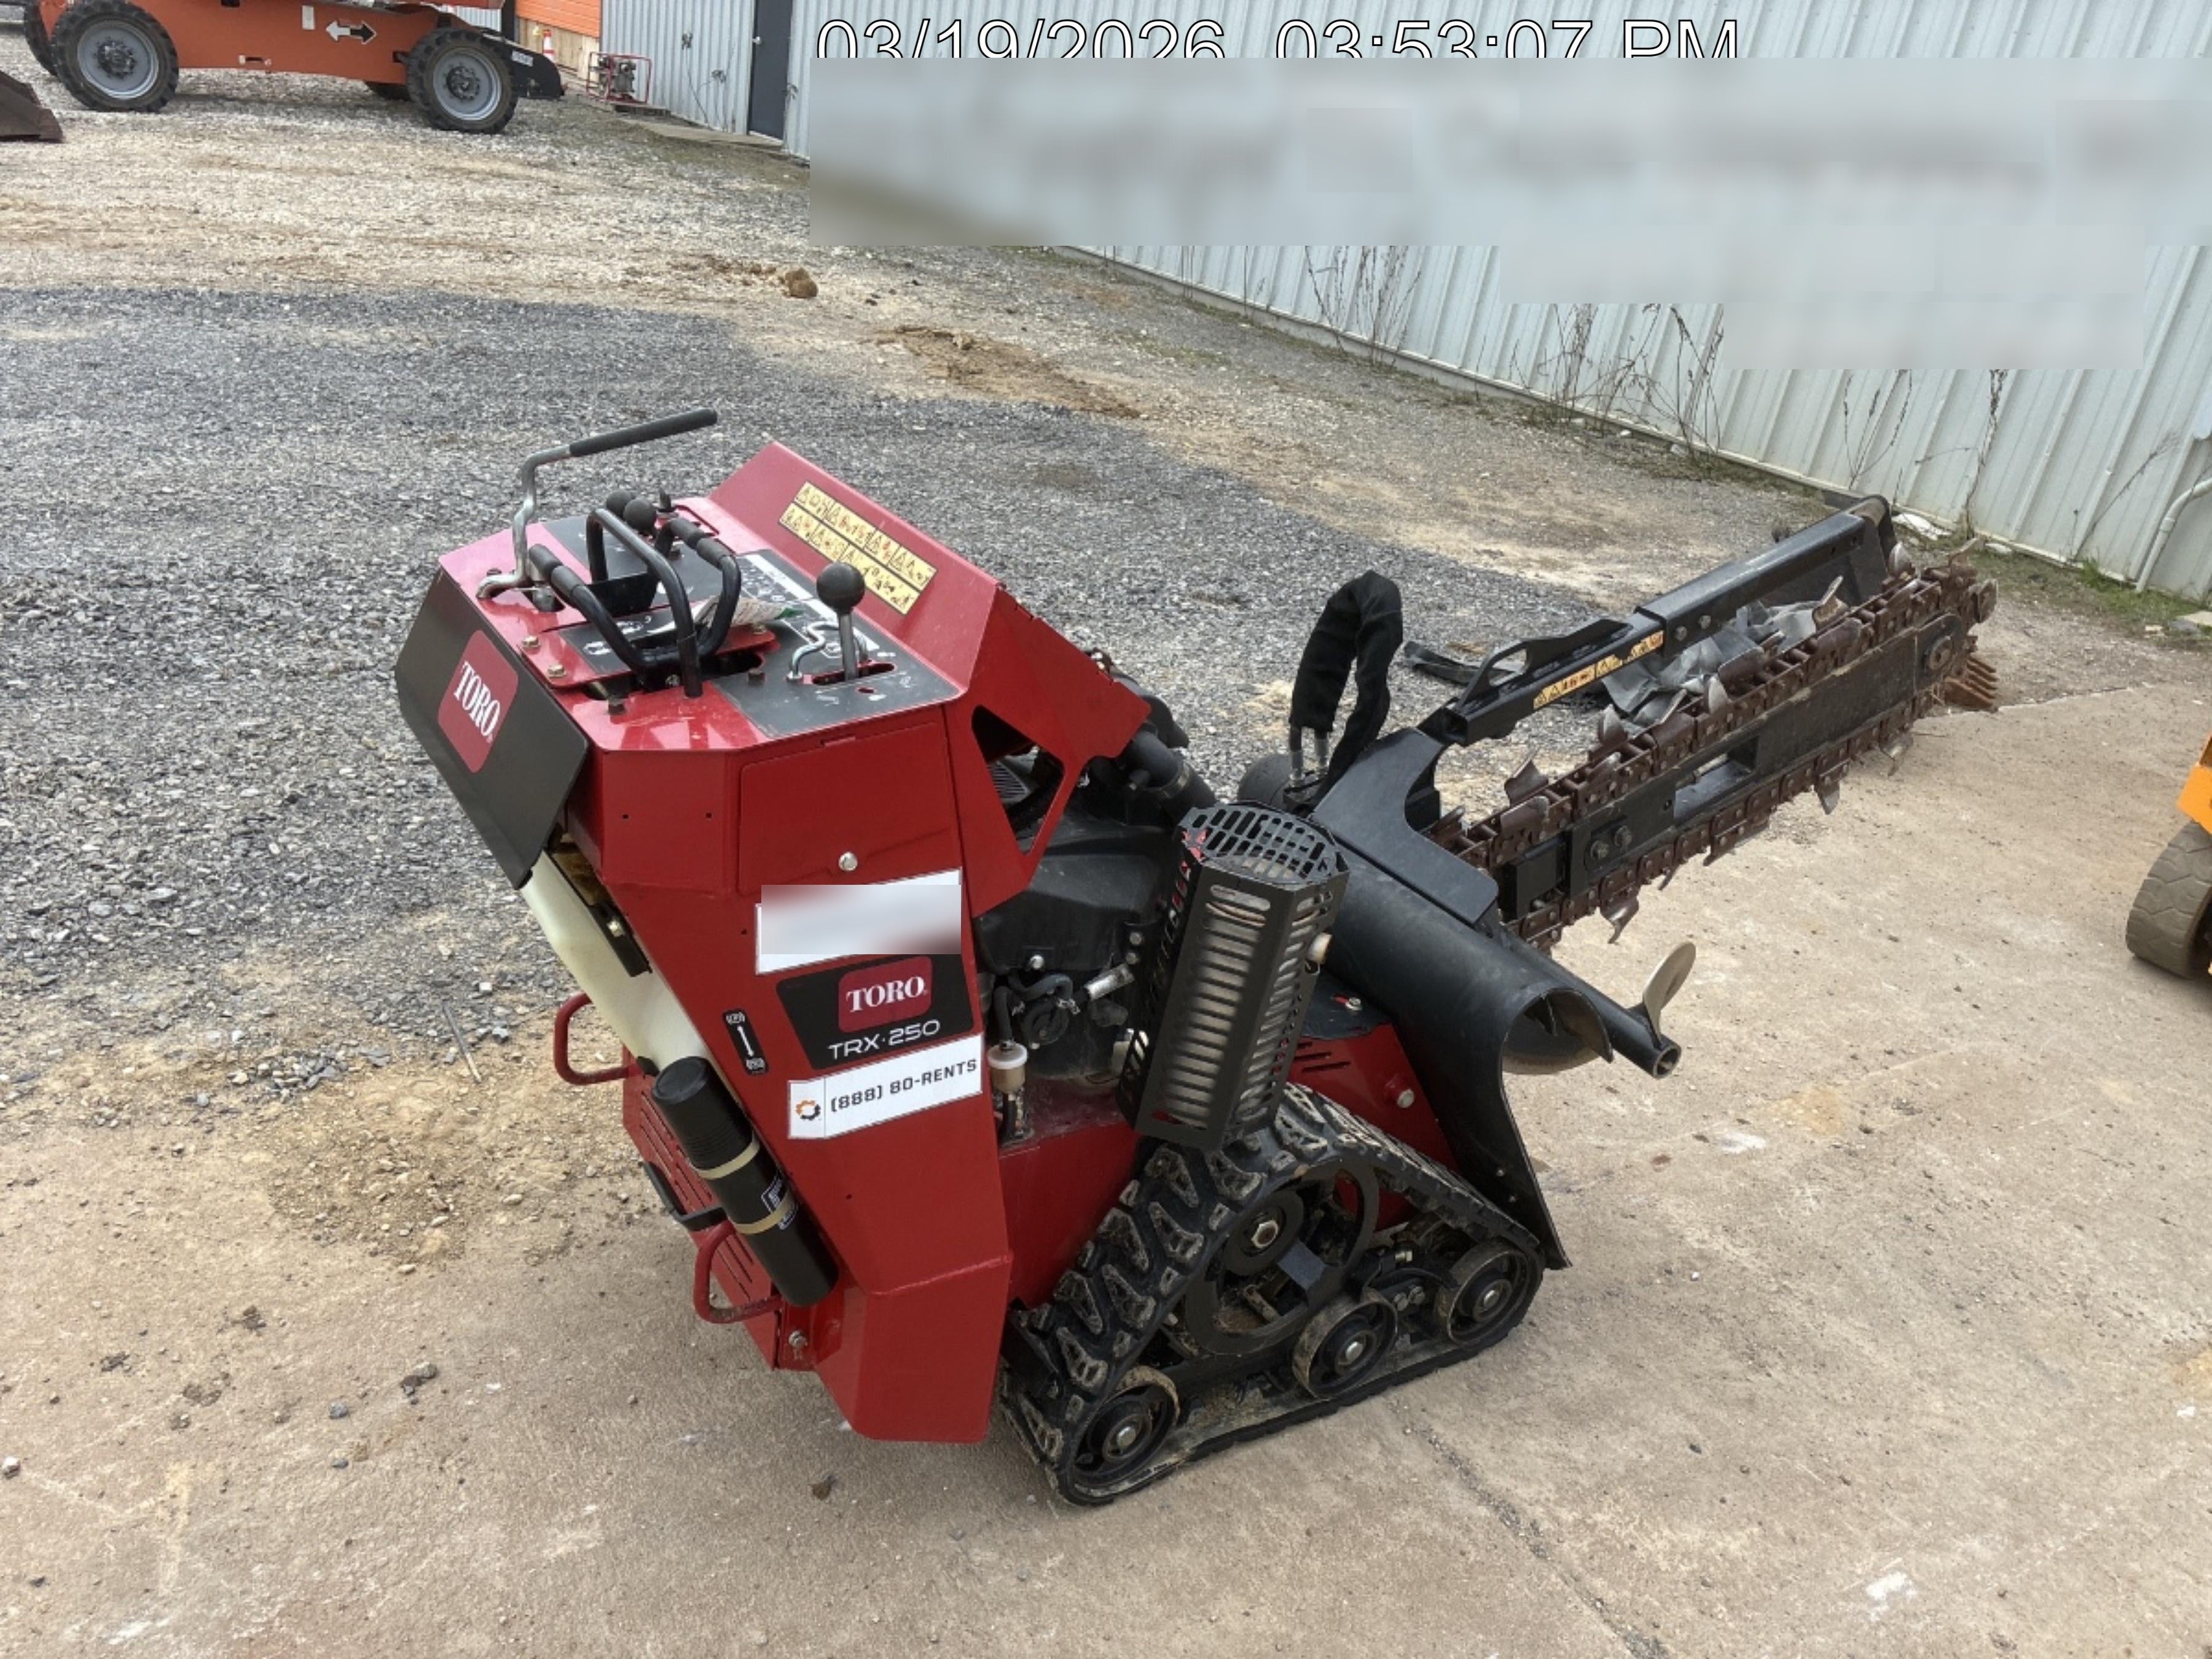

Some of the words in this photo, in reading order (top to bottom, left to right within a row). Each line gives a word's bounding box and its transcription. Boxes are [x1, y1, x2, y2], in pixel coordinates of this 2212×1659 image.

[453, 661, 500, 737] TORO
[845, 976, 925, 1013] TORO
[831, 1085, 883, 1112] (888)
[890, 1058, 977, 1094] 80-RENTS
